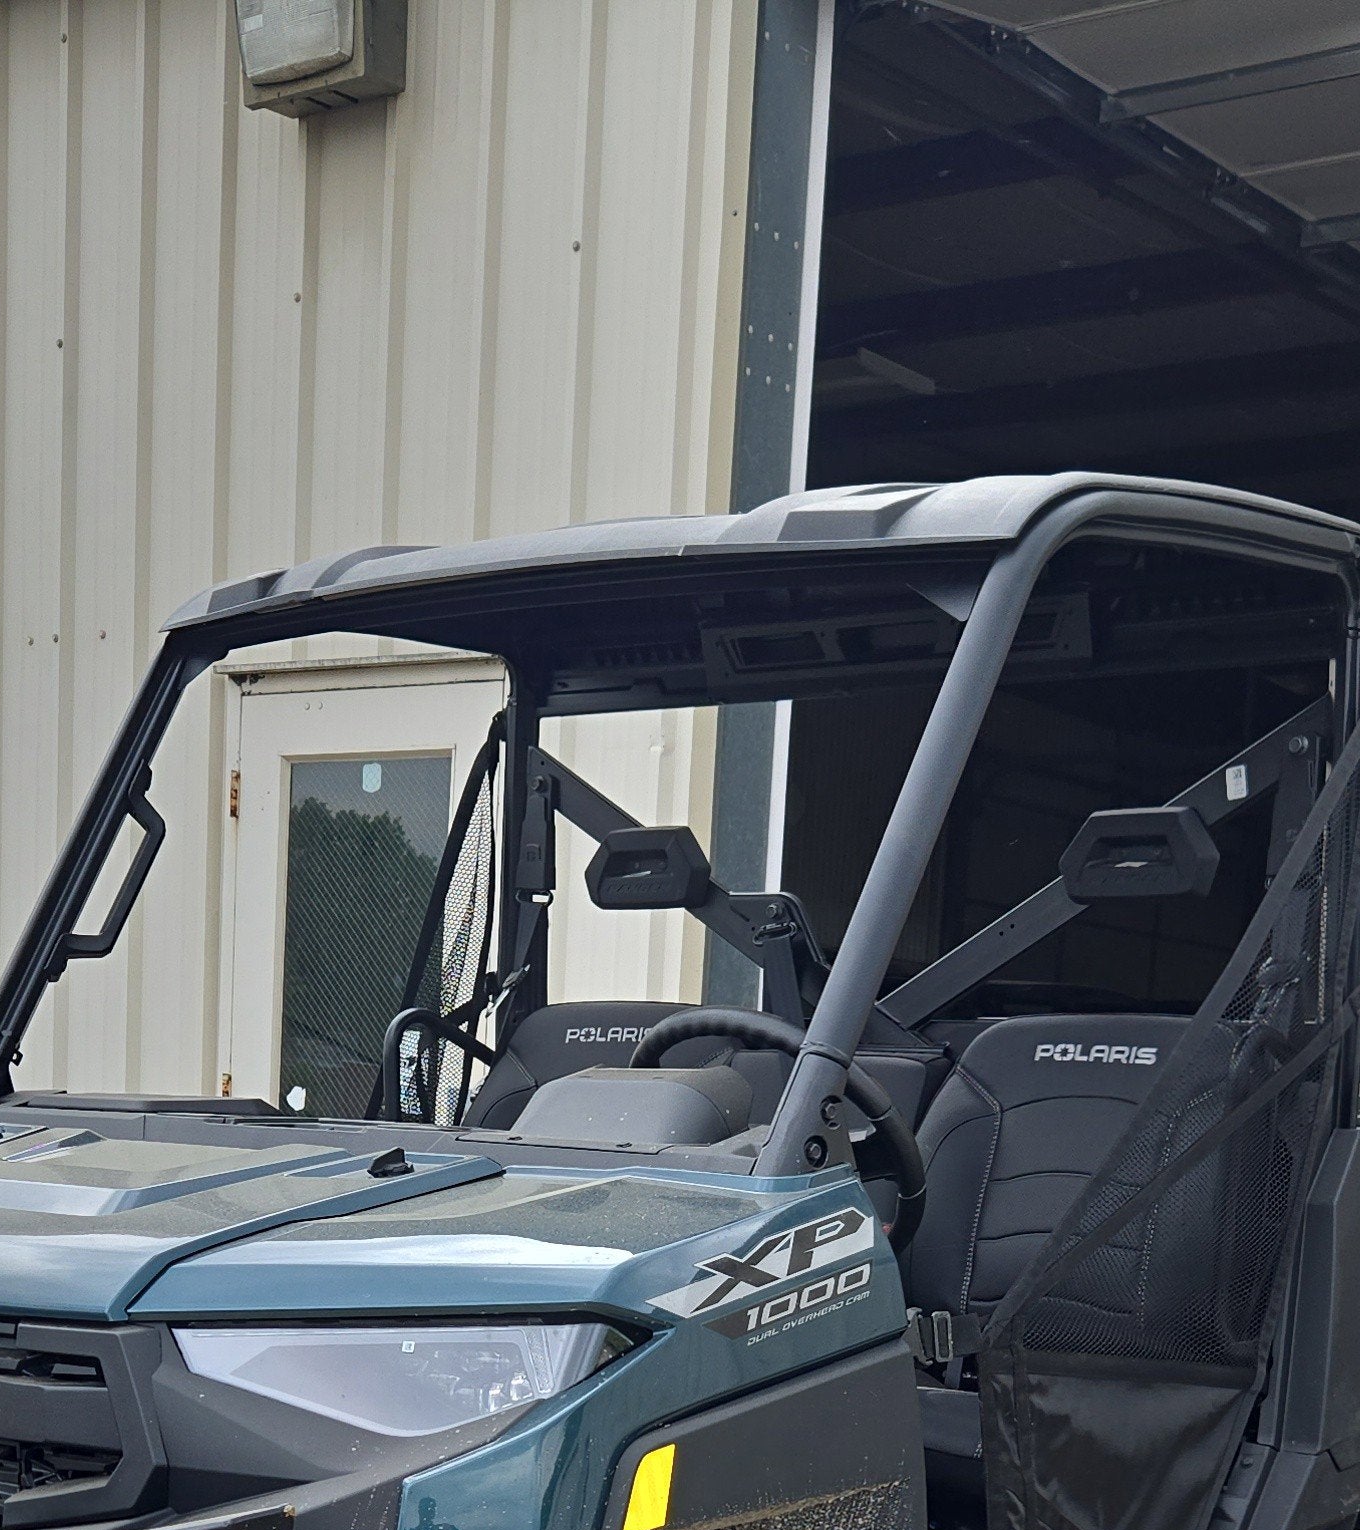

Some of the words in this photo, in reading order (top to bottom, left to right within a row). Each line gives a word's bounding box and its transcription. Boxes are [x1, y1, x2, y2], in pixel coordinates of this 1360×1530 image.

[1034, 1043, 1158, 1065] POLARIS
[690, 1207, 868, 1314] XP
[746, 1263, 871, 1332] 1000
[747, 1328, 779, 1346] DUAL
[782, 1300, 844, 1331] OVERHEAD
[845, 1291, 871, 1306] CAM
